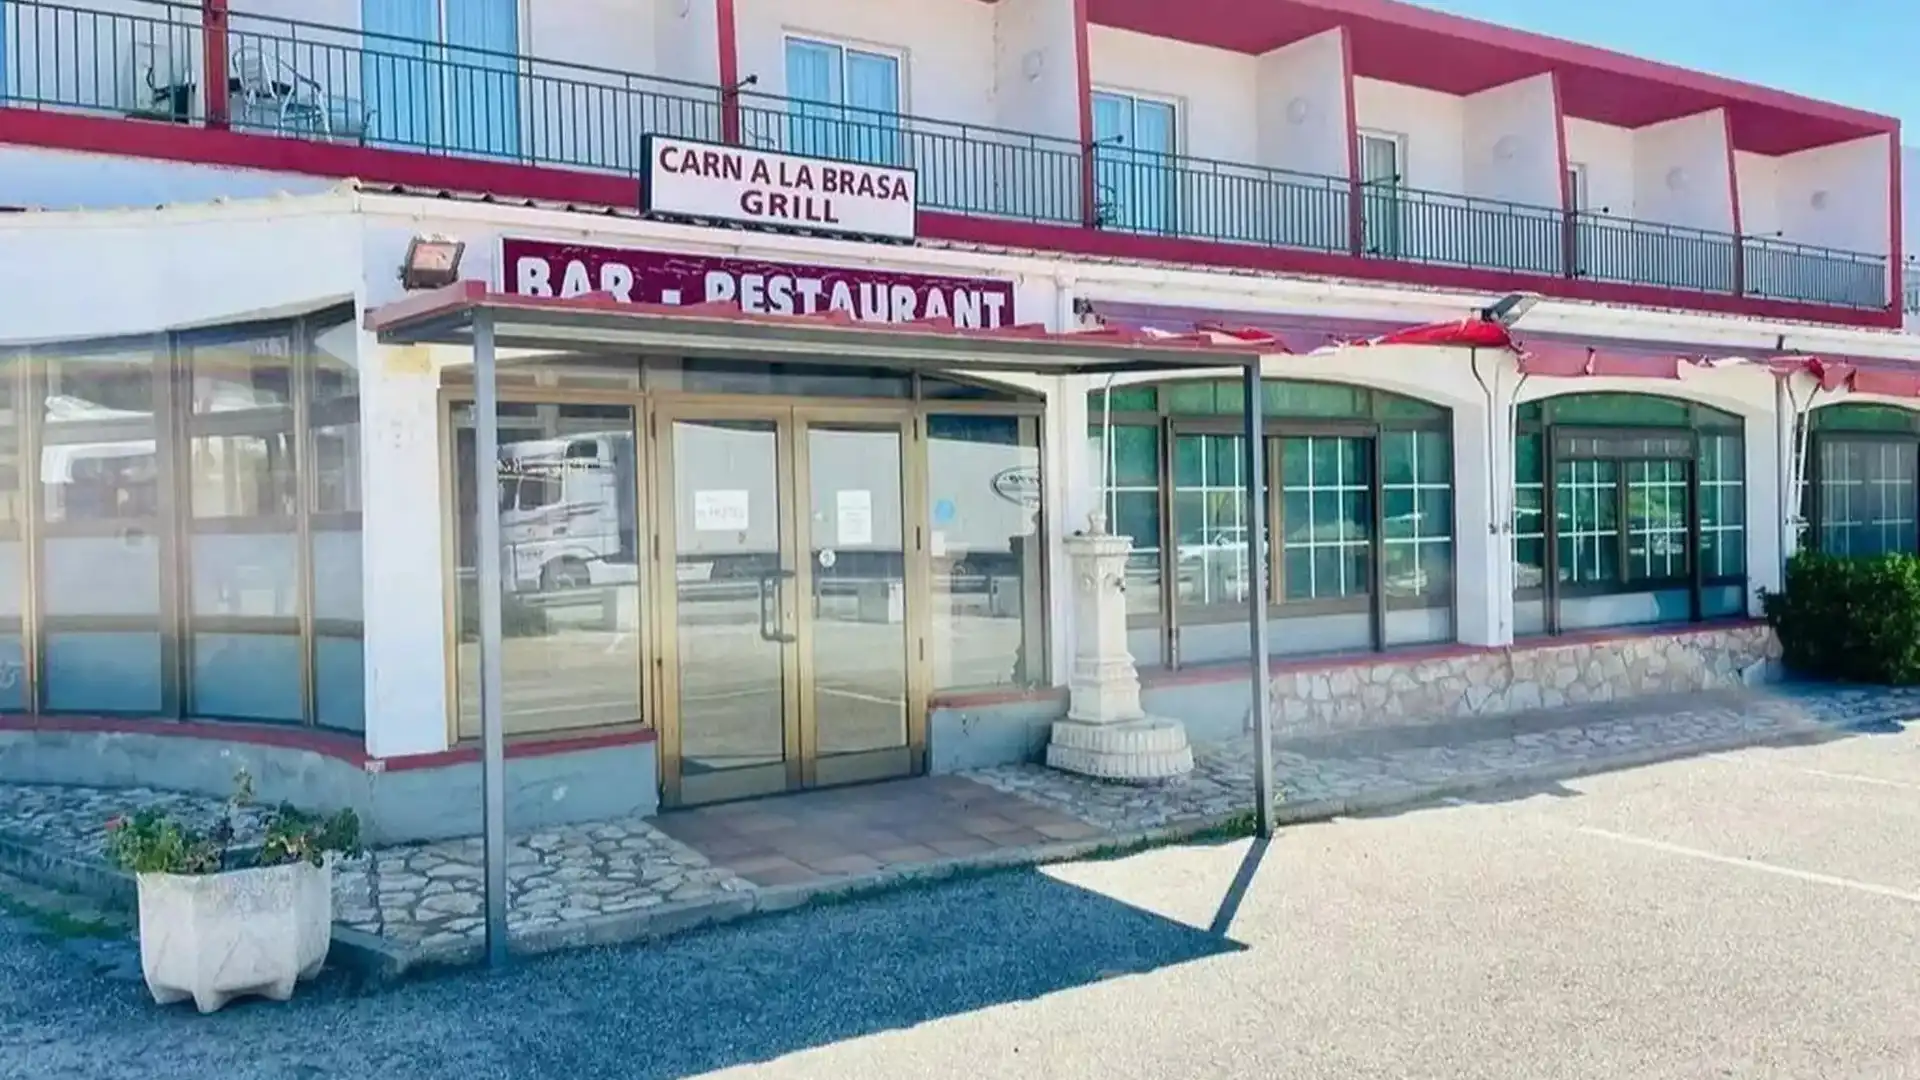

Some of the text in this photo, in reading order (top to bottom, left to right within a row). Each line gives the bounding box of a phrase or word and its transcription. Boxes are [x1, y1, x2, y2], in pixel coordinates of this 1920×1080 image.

[659, 146, 909, 202] CARN A LA BRASA
[740, 190, 839, 224] GRILL
[517, 256, 632, 304] BAR
[704, 271, 1004, 330] RESTAURANT
